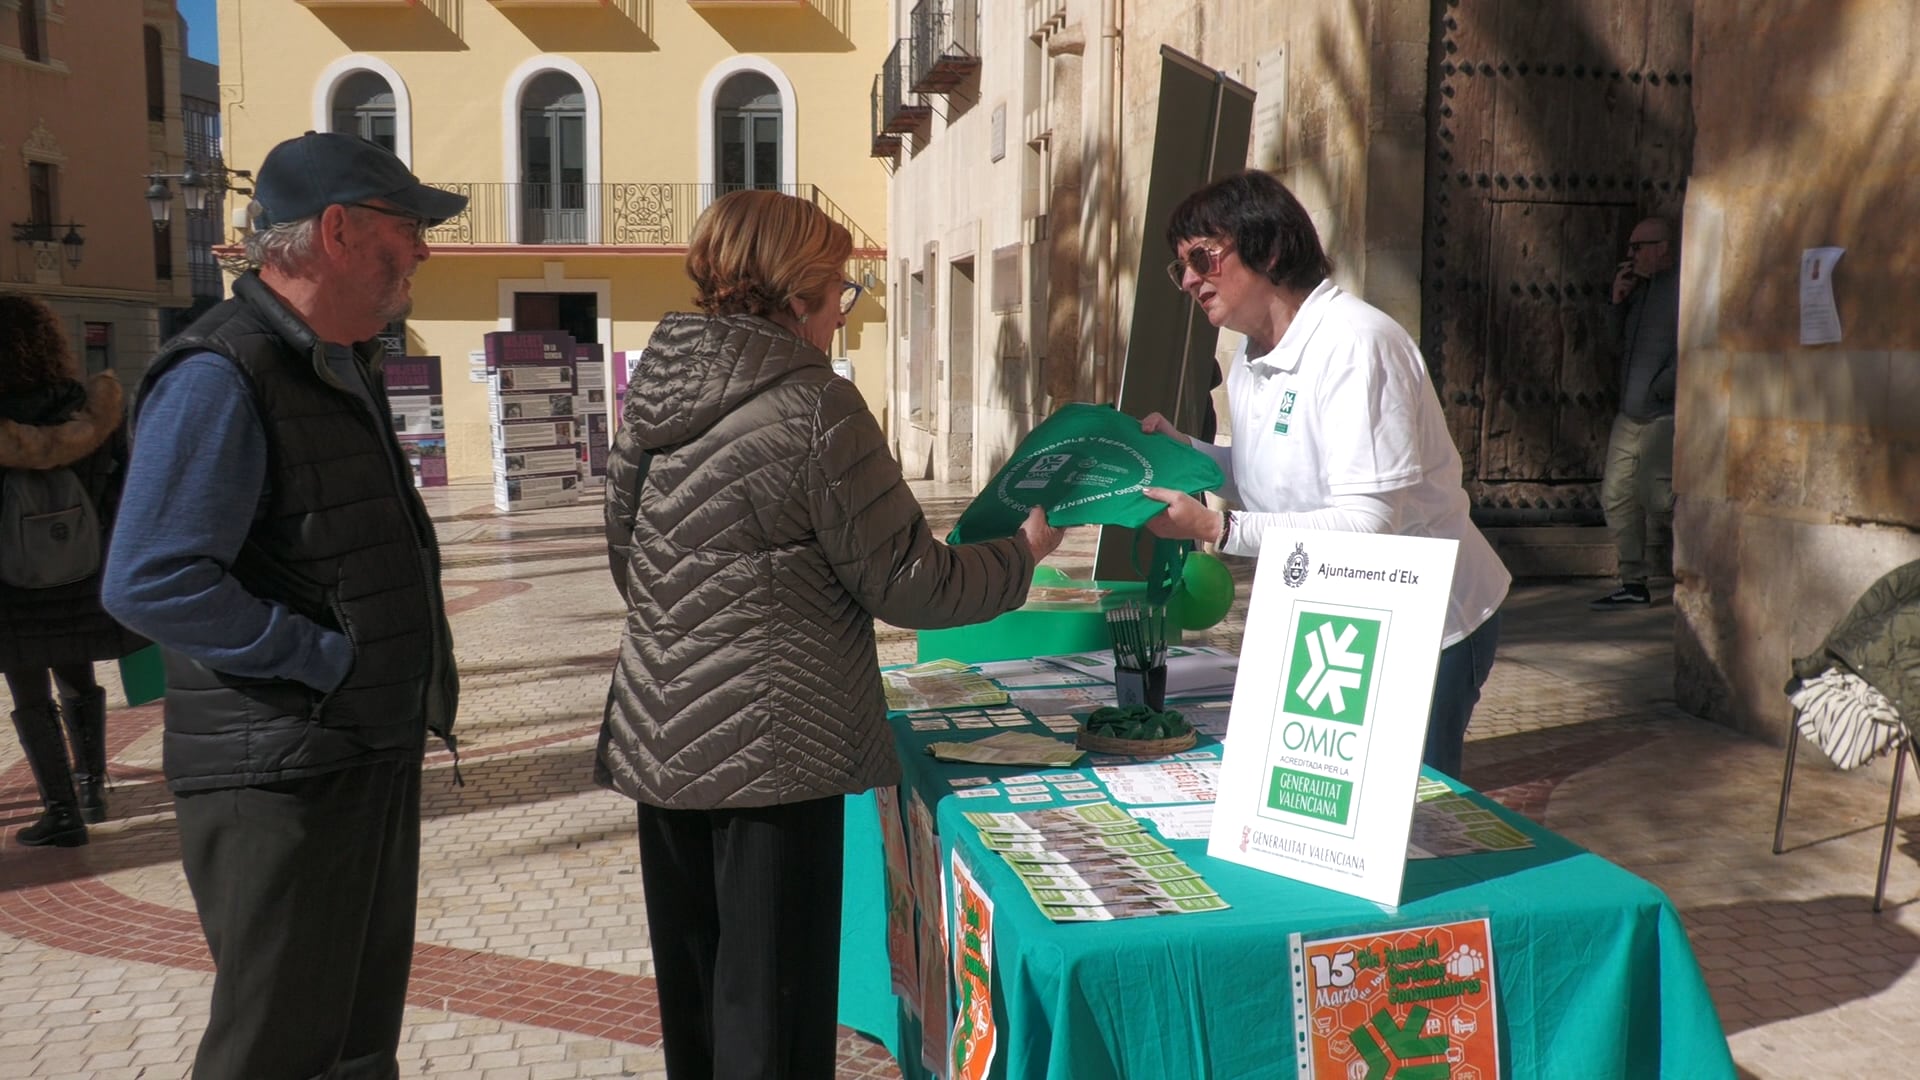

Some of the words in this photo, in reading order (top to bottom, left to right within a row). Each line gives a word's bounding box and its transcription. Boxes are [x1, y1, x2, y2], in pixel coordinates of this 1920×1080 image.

[1317, 562, 1386, 582] Ajuntament
[1388, 568, 1420, 585] d'Elx
[1282, 720, 1358, 762] OMIC
[1279, 755, 1323, 771] ACREDITADA
[1323, 764, 1339, 774] PER
[1339, 767, 1350, 777] LA
[1279, 772, 1343, 801] GENERALITAT
[1278, 789, 1337, 818] VALENCIANA
[1252, 830, 1307, 857] GENERALITAT
[1309, 844, 1366, 872] VALENCIANA
[1385, 937, 1440, 965] Mundial
[1311, 951, 1356, 988] 15
[1315, 986, 1359, 1009] Marzo
[1388, 977, 1482, 1005] Consumidores
